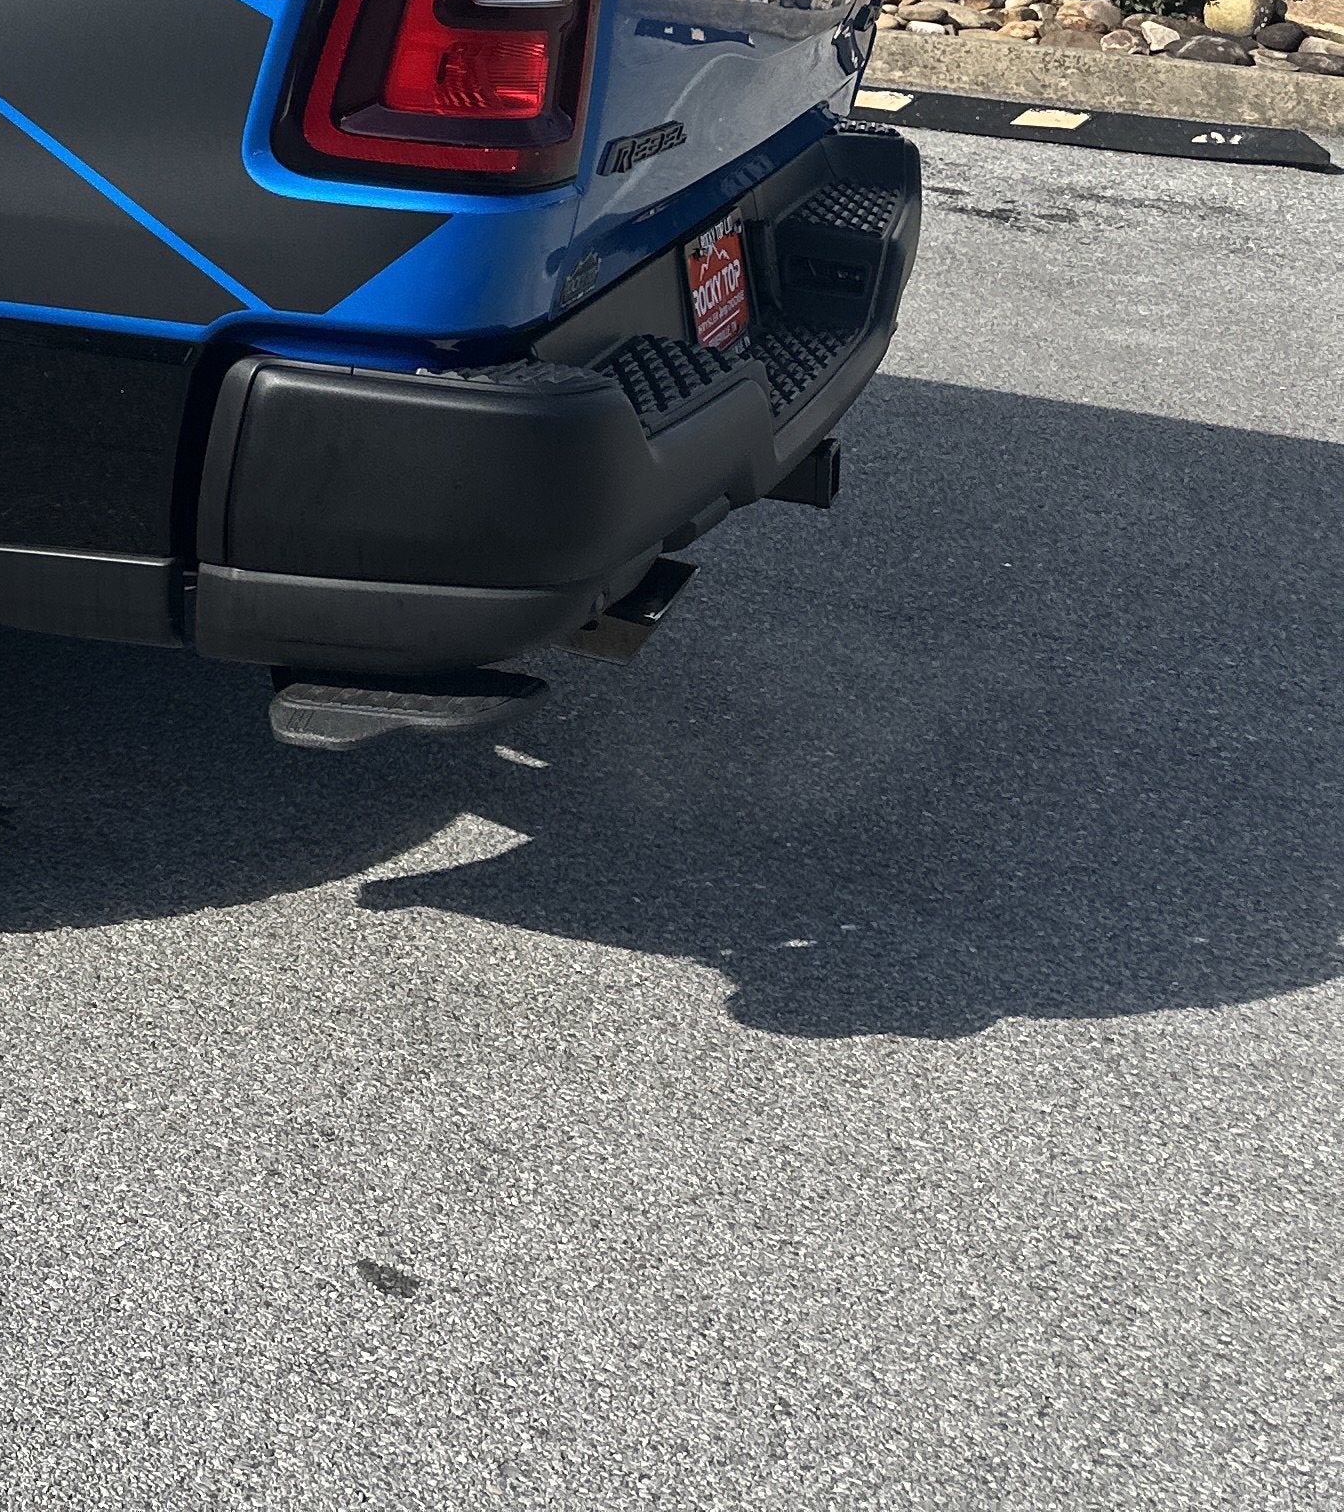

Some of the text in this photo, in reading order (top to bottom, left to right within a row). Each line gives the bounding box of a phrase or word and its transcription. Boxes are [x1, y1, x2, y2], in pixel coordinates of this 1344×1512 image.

[599, 120, 688, 175] REBEL
[692, 259, 742, 318] ROCKY TOP
